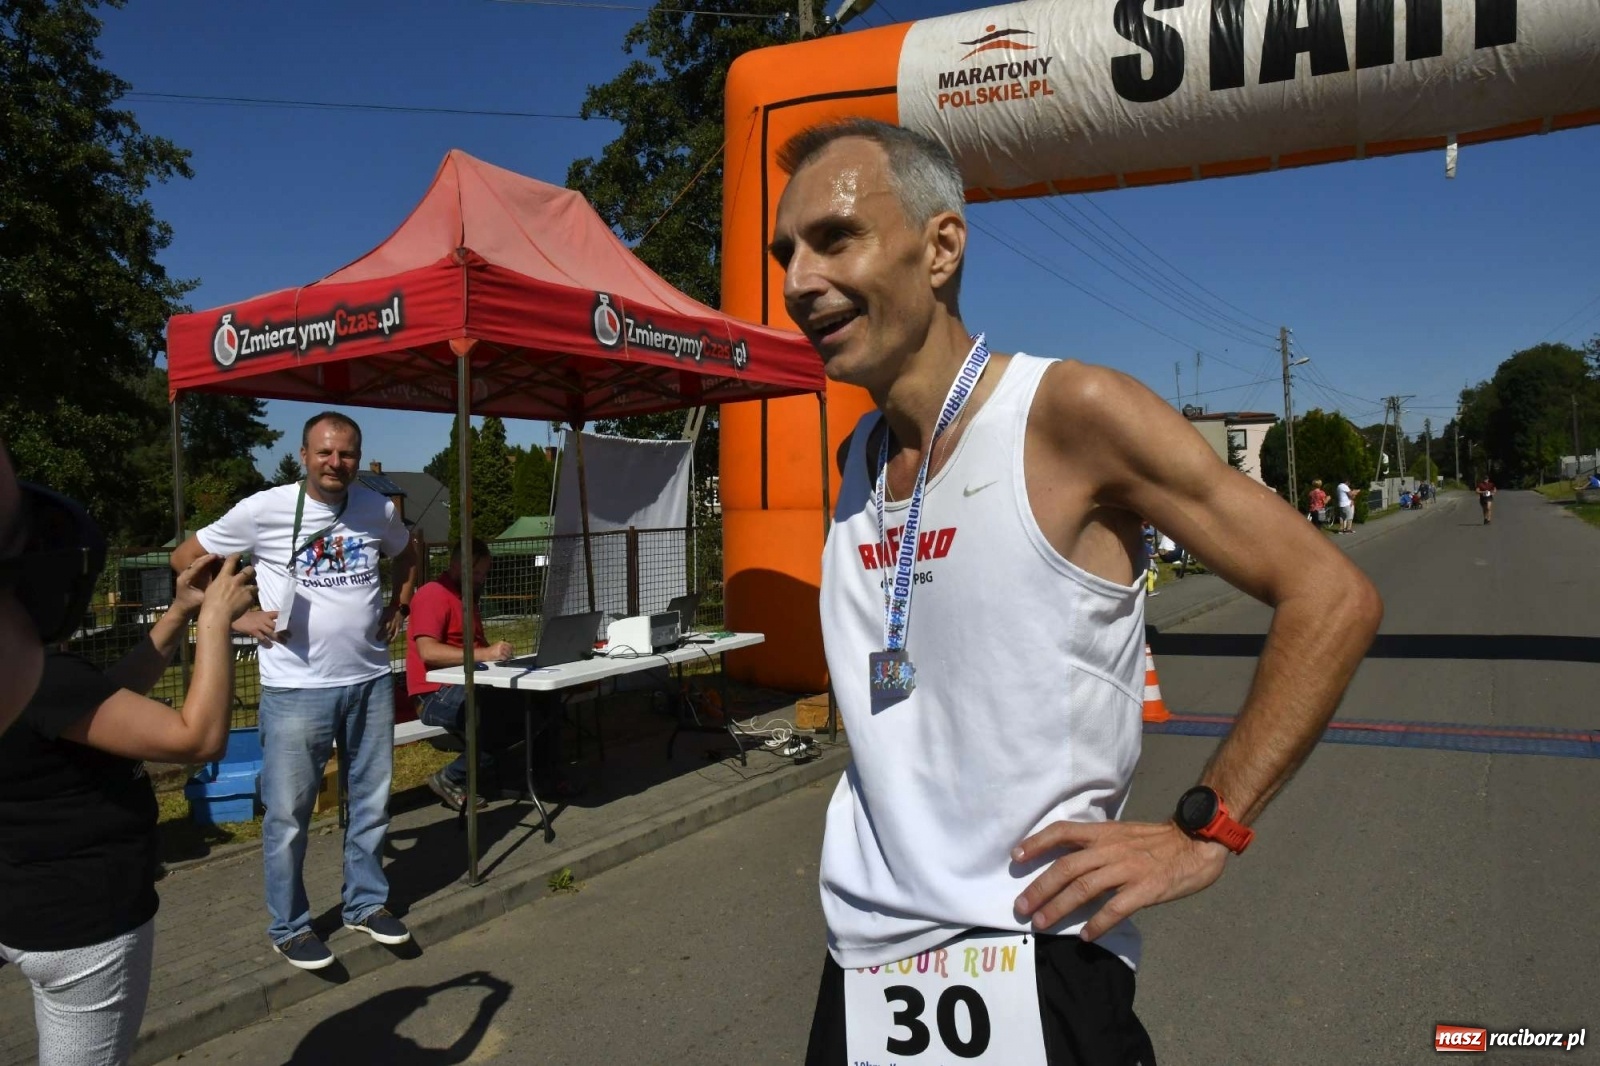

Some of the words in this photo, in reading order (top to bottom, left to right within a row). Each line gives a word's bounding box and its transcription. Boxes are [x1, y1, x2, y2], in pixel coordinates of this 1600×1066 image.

[938, 56, 1053, 90] MARATONY
[938, 79, 1054, 110] POLSKIE.PL
[953, 346, 989, 398] COLOUR
[938, 397, 961, 431] RUN
[858, 524, 957, 570] RAFKO
[893, 534, 916, 598] COLOUR
[907, 498, 921, 532] RUN
[302, 575, 348, 588] COLOUR
[913, 571, 933, 585] PBG
[963, 945, 1018, 978] RUN
[883, 984, 991, 1058] 30
